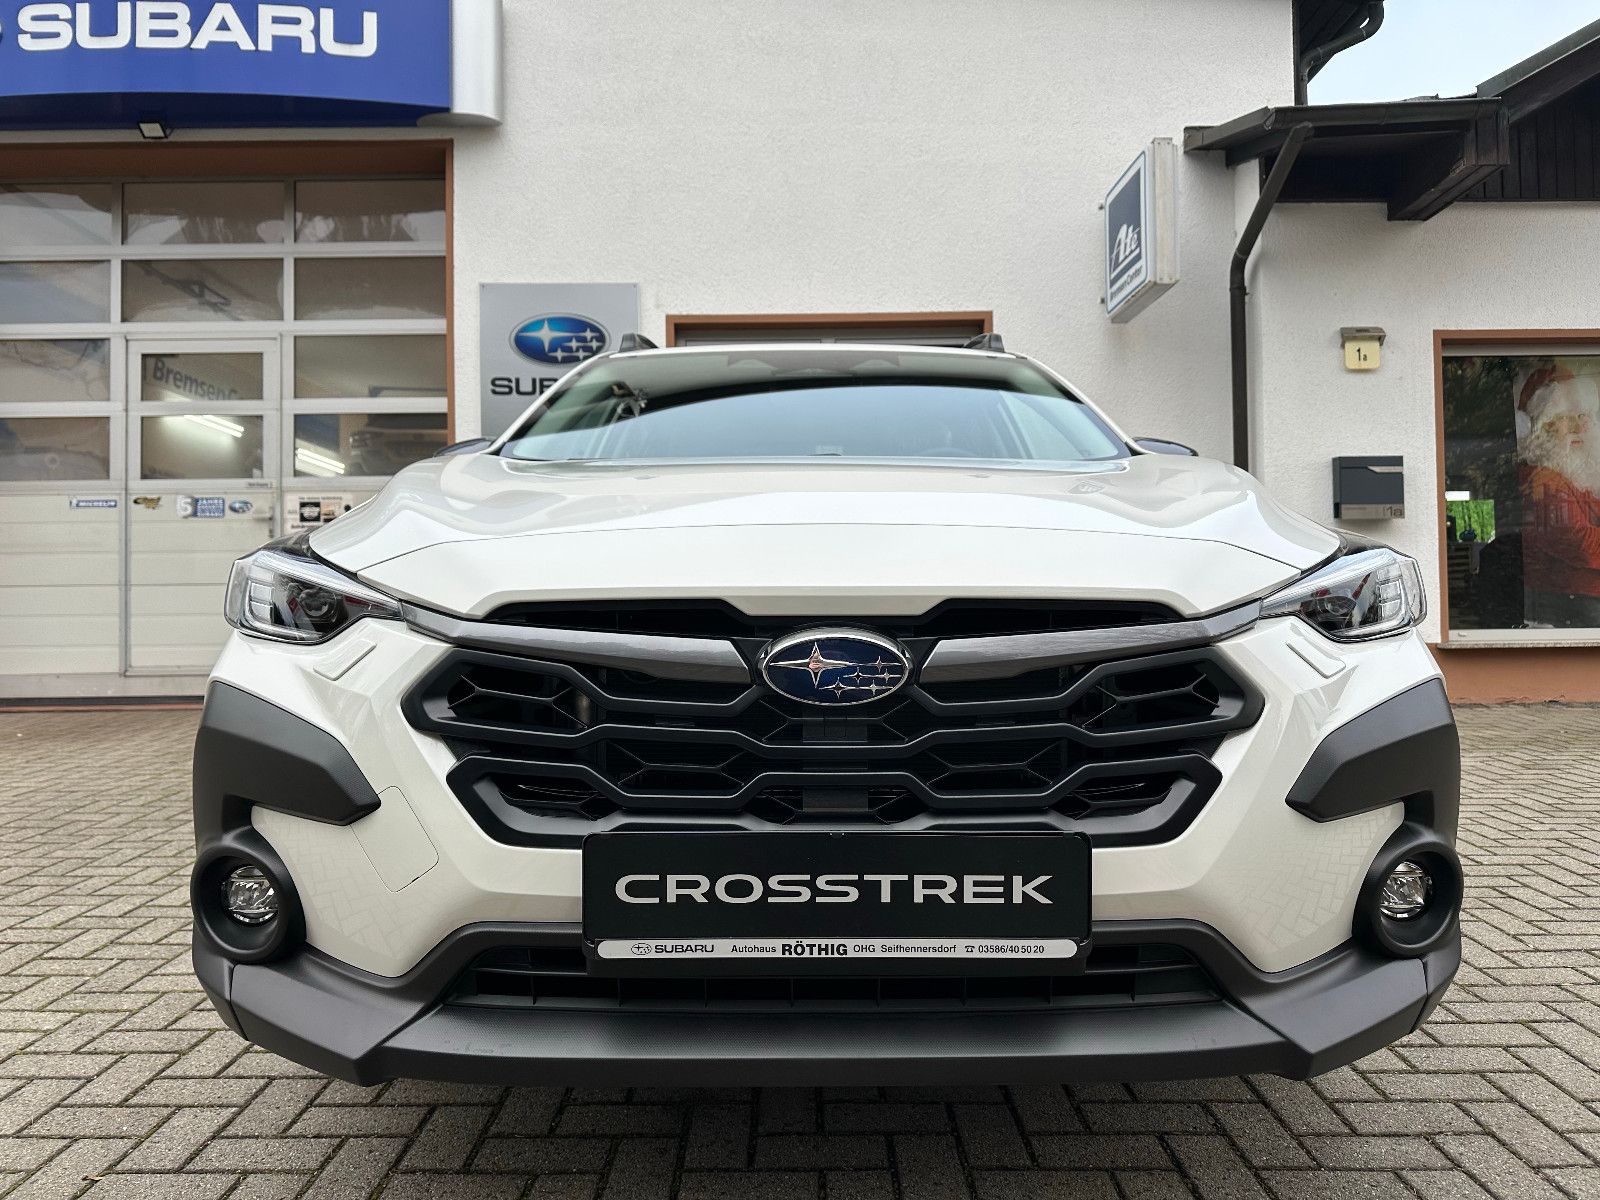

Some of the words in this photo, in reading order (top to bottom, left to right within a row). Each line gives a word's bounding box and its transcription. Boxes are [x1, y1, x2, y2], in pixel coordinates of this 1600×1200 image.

[17, 0, 378, 57] SUBARU
[1356, 347, 1368, 362] 1a
[615, 873, 1054, 904] CROSSTREK
[654, 944, 715, 954] SUBARU
[730, 944, 777, 954] Autohaus
[781, 941, 848, 956] RÖTHIG
[853, 944, 876, 954] OHG
[880, 944, 957, 954] Seifhennersdorf
